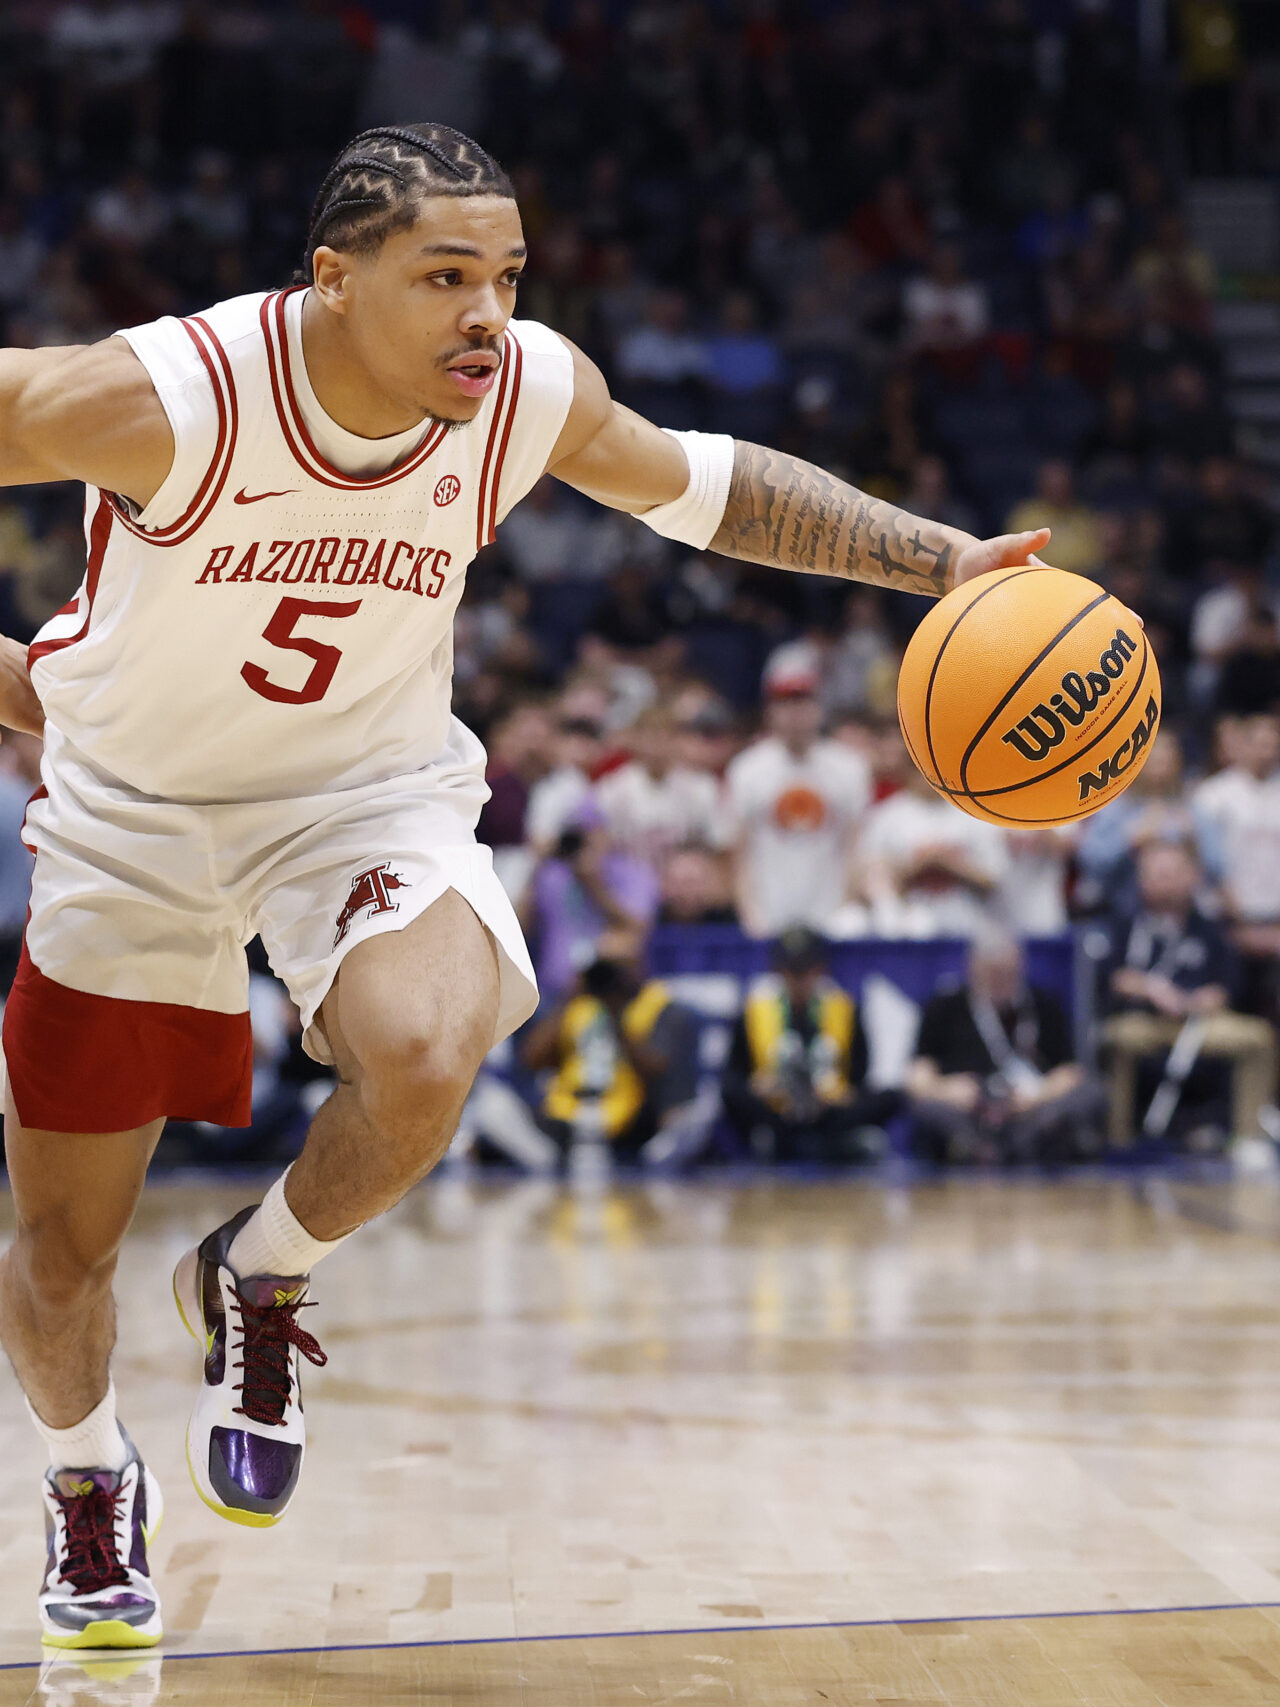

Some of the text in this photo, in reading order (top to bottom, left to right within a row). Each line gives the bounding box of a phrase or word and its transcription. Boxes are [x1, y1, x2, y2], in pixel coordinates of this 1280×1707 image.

[436, 477, 459, 505] SEC
[195, 536, 452, 599] RAZORBACKS
[240, 596, 363, 705] 5
[1001, 628, 1138, 762] Wilson
[1075, 681, 1128, 742] INDOOR GAME BALL
[1078, 695, 1158, 801] NCAA
